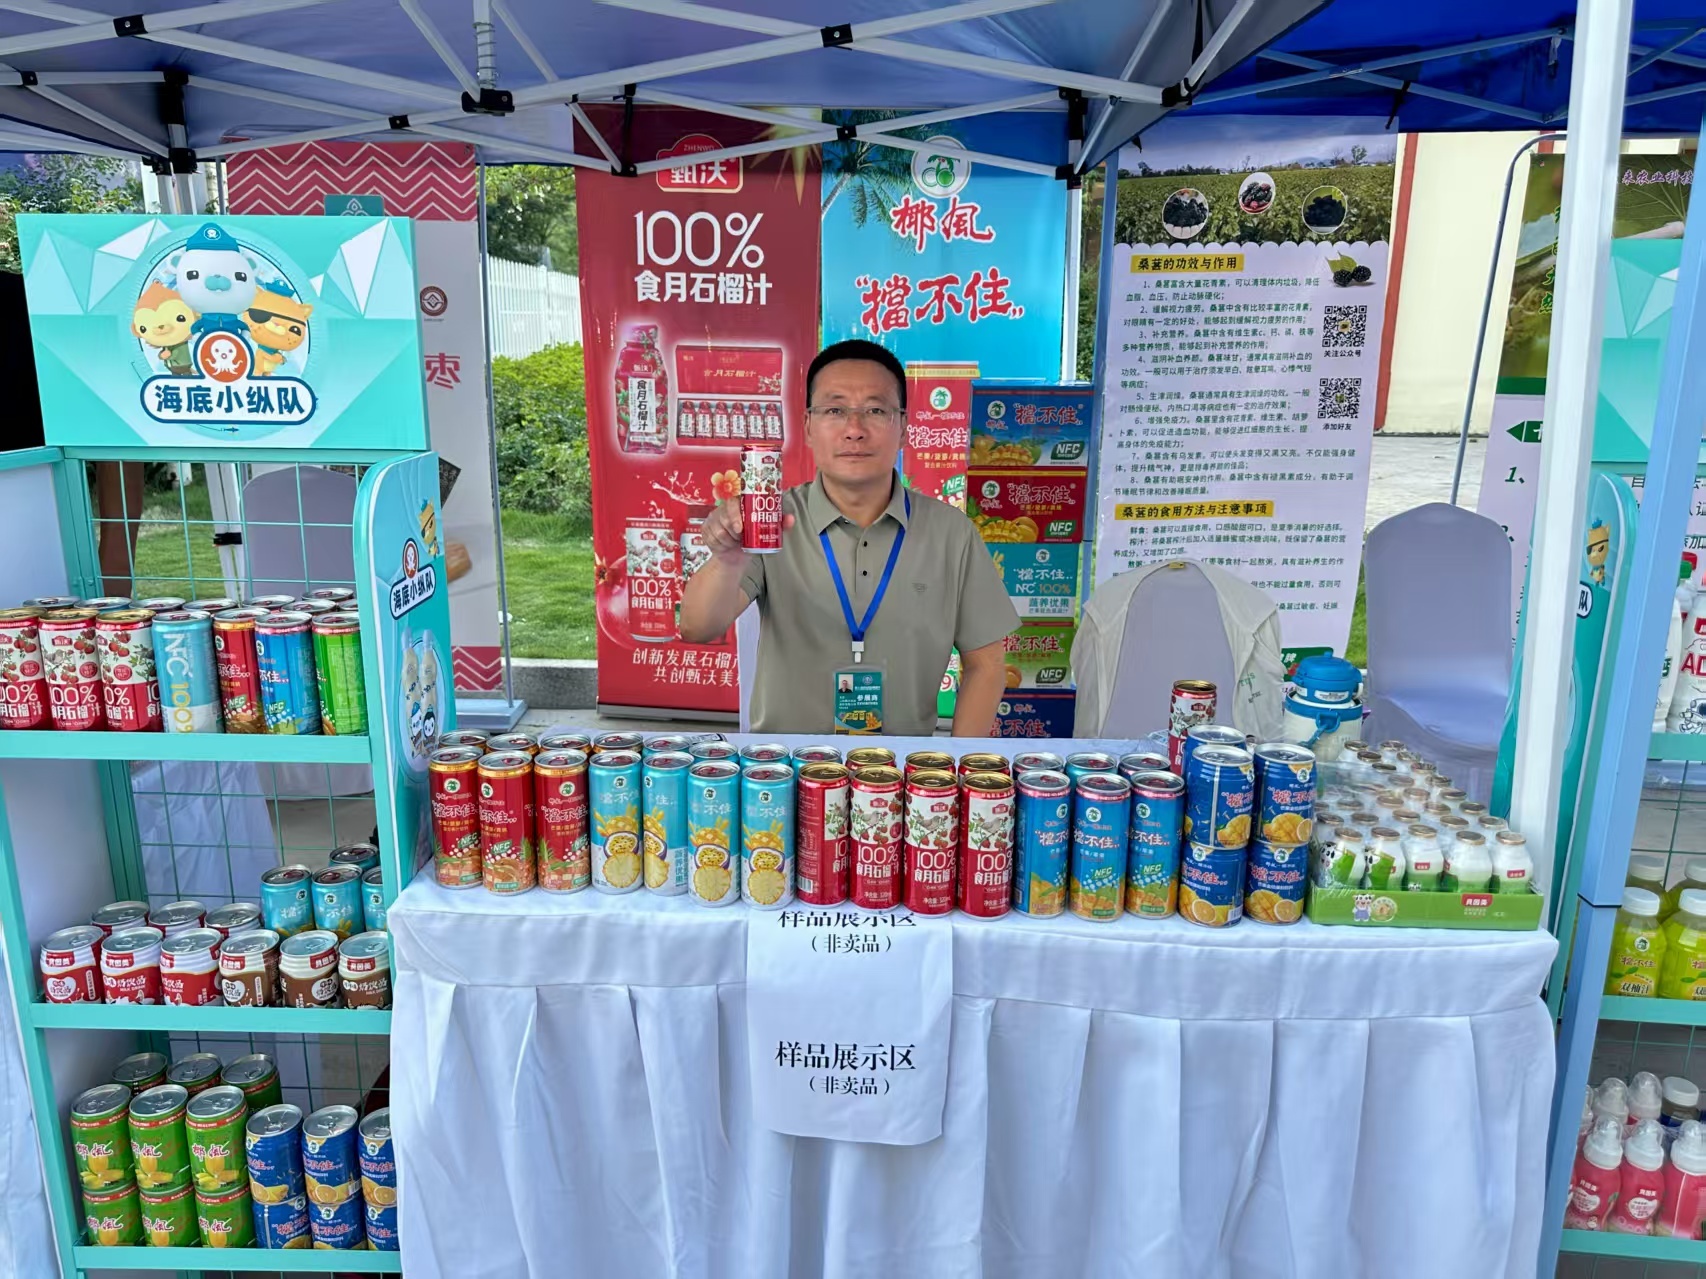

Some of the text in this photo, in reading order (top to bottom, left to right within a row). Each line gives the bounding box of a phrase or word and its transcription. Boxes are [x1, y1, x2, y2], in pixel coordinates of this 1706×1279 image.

[671, 160, 728, 185] 甄沃
[634, 210, 764, 268] 100%
[1138, 257, 1237, 270] 桑葚的功效与作用
[634, 270, 773, 305] 食月石榴汁
[1323, 349, 1361, 358] 关注公众号
[155, 383, 306, 416] 海底小纵队
[637, 380, 648, 431] 食月石榴汁
[1322, 422, 1352, 431] 添加好友
[1055, 443, 1081, 454] NFC
[1122, 503, 1267, 519] 桑葚的食用方法与注意事项
[1049, 521, 1073, 532] NFC
[392, 574, 434, 614] 海底小纵队
[631, 580, 672, 597] 100%
[1039, 583, 1071, 594] 100%
[653, 666, 740, 687] 共创甄沃美
[1040, 668, 1063, 679] NFC
[49, 683, 98, 705] 100%
[462, 832, 477, 843] NFC
[493, 841, 511, 852] NFC
[858, 844, 899, 865] 100%
[917, 849, 956, 870] 100%
[1094, 866, 1112, 877] NFC
[1143, 864, 1161, 874] NFC
[811, 933, 892, 953] （非卖品）
[116, 975, 147, 987] 奶饮品
[775, 1040, 916, 1071] 样品展示区
[809, 1076, 890, 1095] （非卖品）
